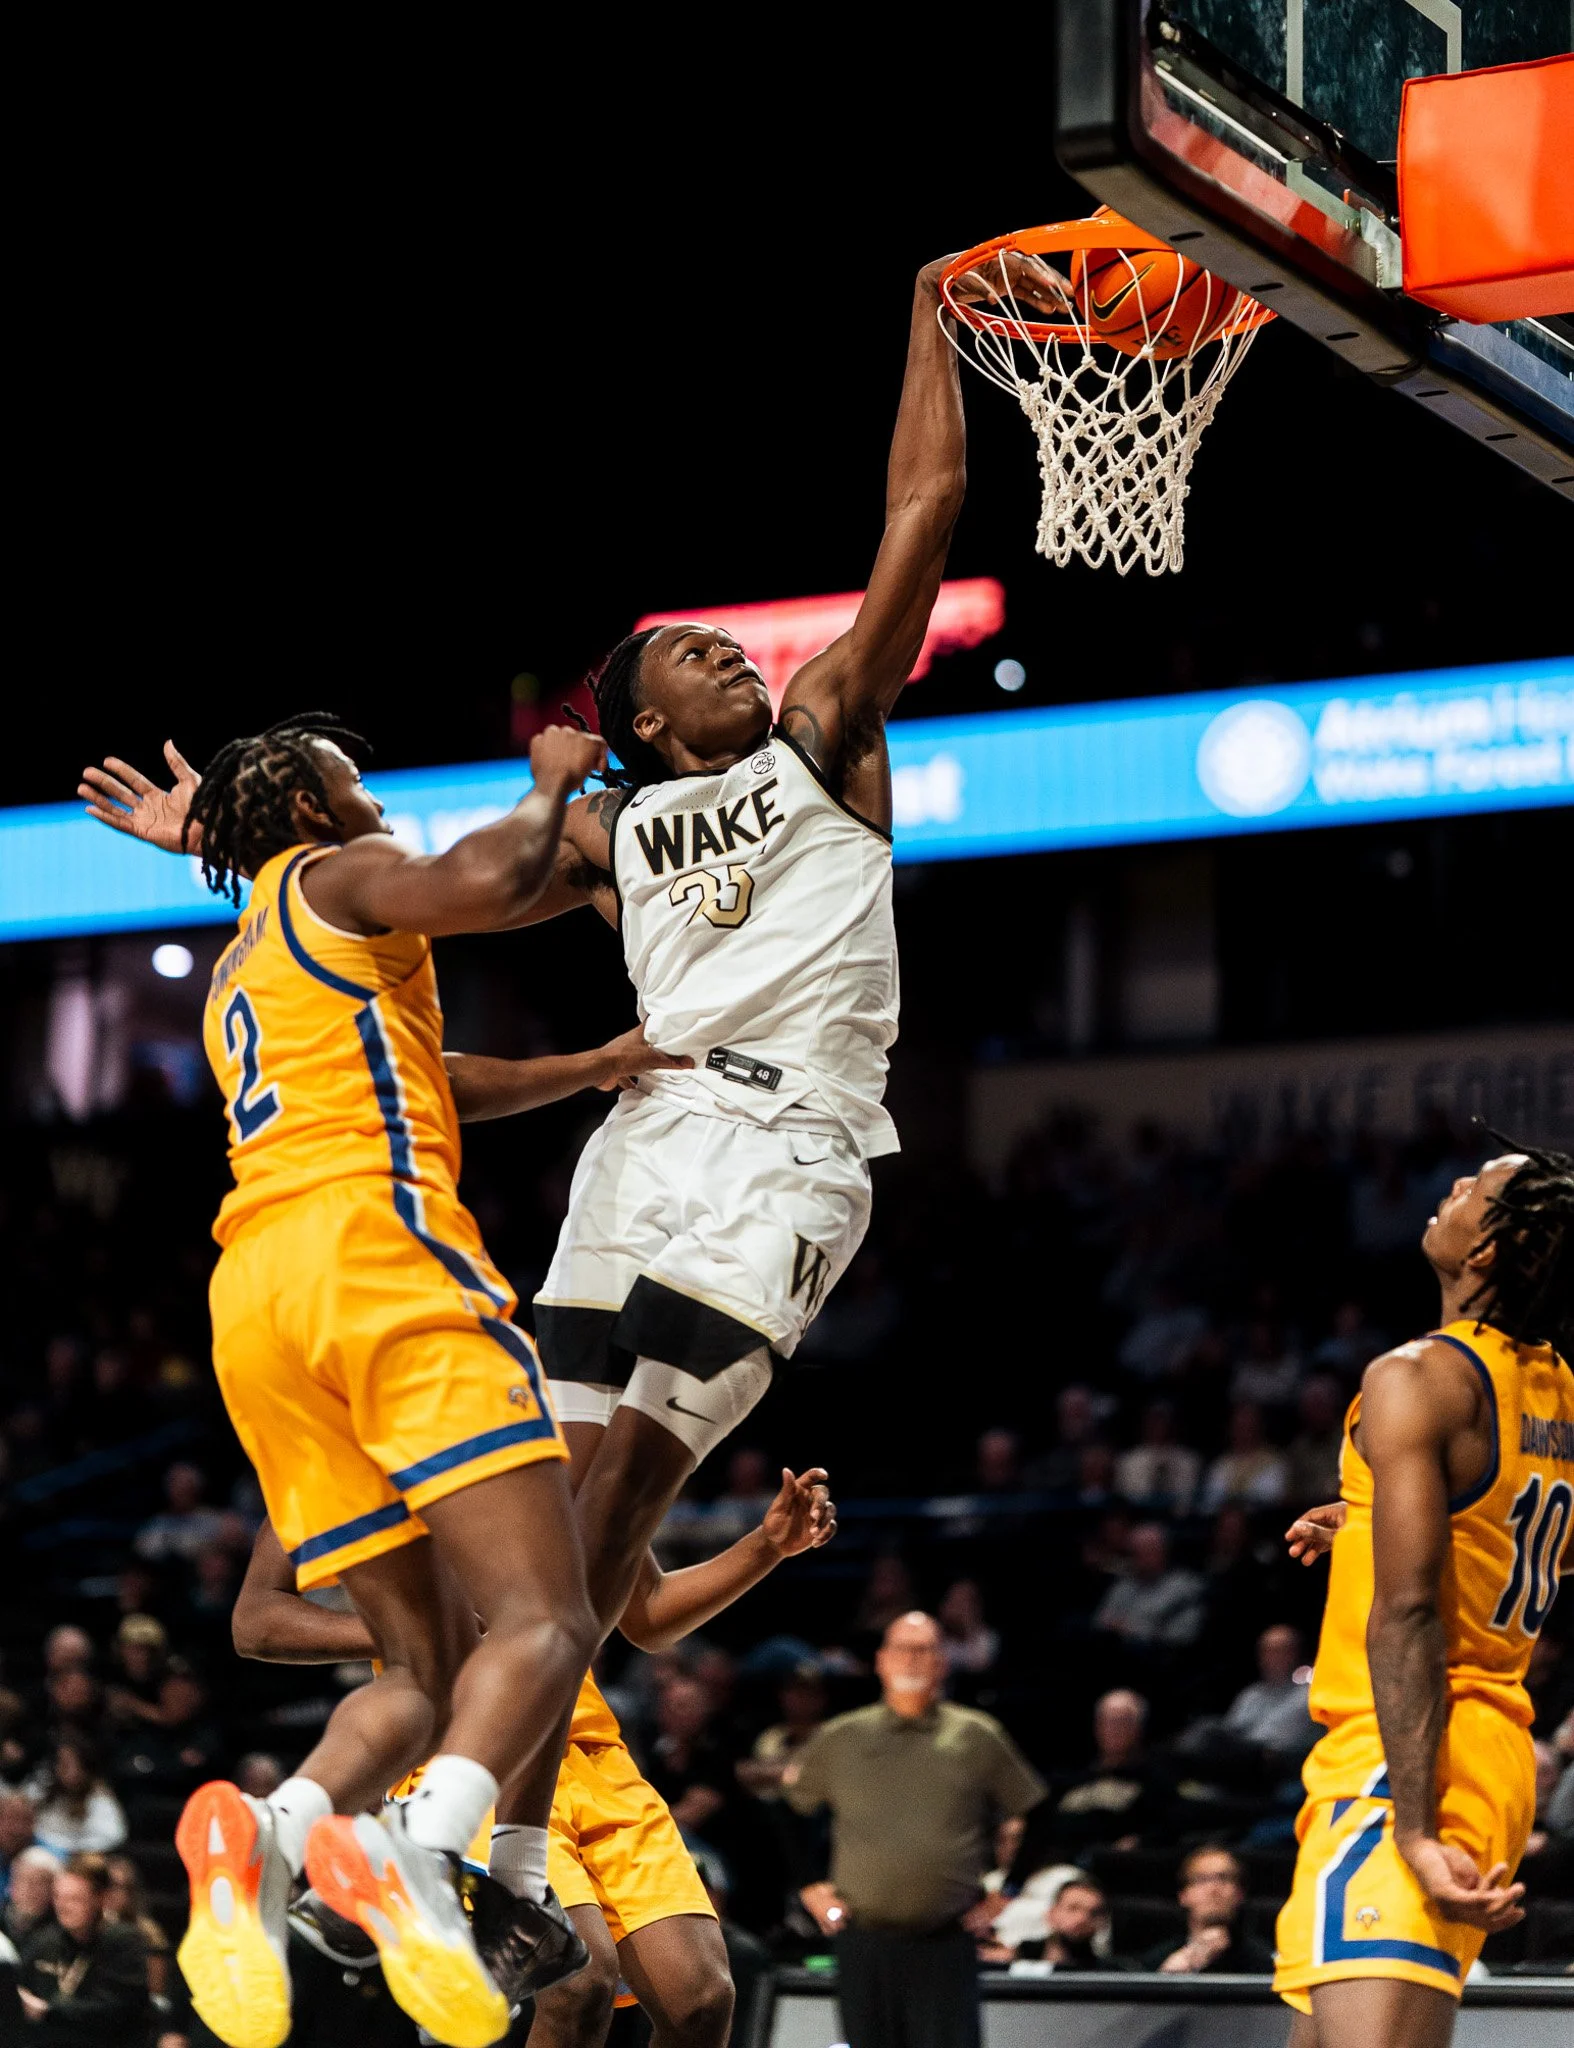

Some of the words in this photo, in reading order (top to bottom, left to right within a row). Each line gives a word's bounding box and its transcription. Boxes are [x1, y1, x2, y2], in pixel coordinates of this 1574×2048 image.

[633, 777, 787, 876] WAKE
[221, 984, 284, 1145] 2
[757, 1069, 770, 1080] 48
[1489, 1471, 1574, 1639] 10
